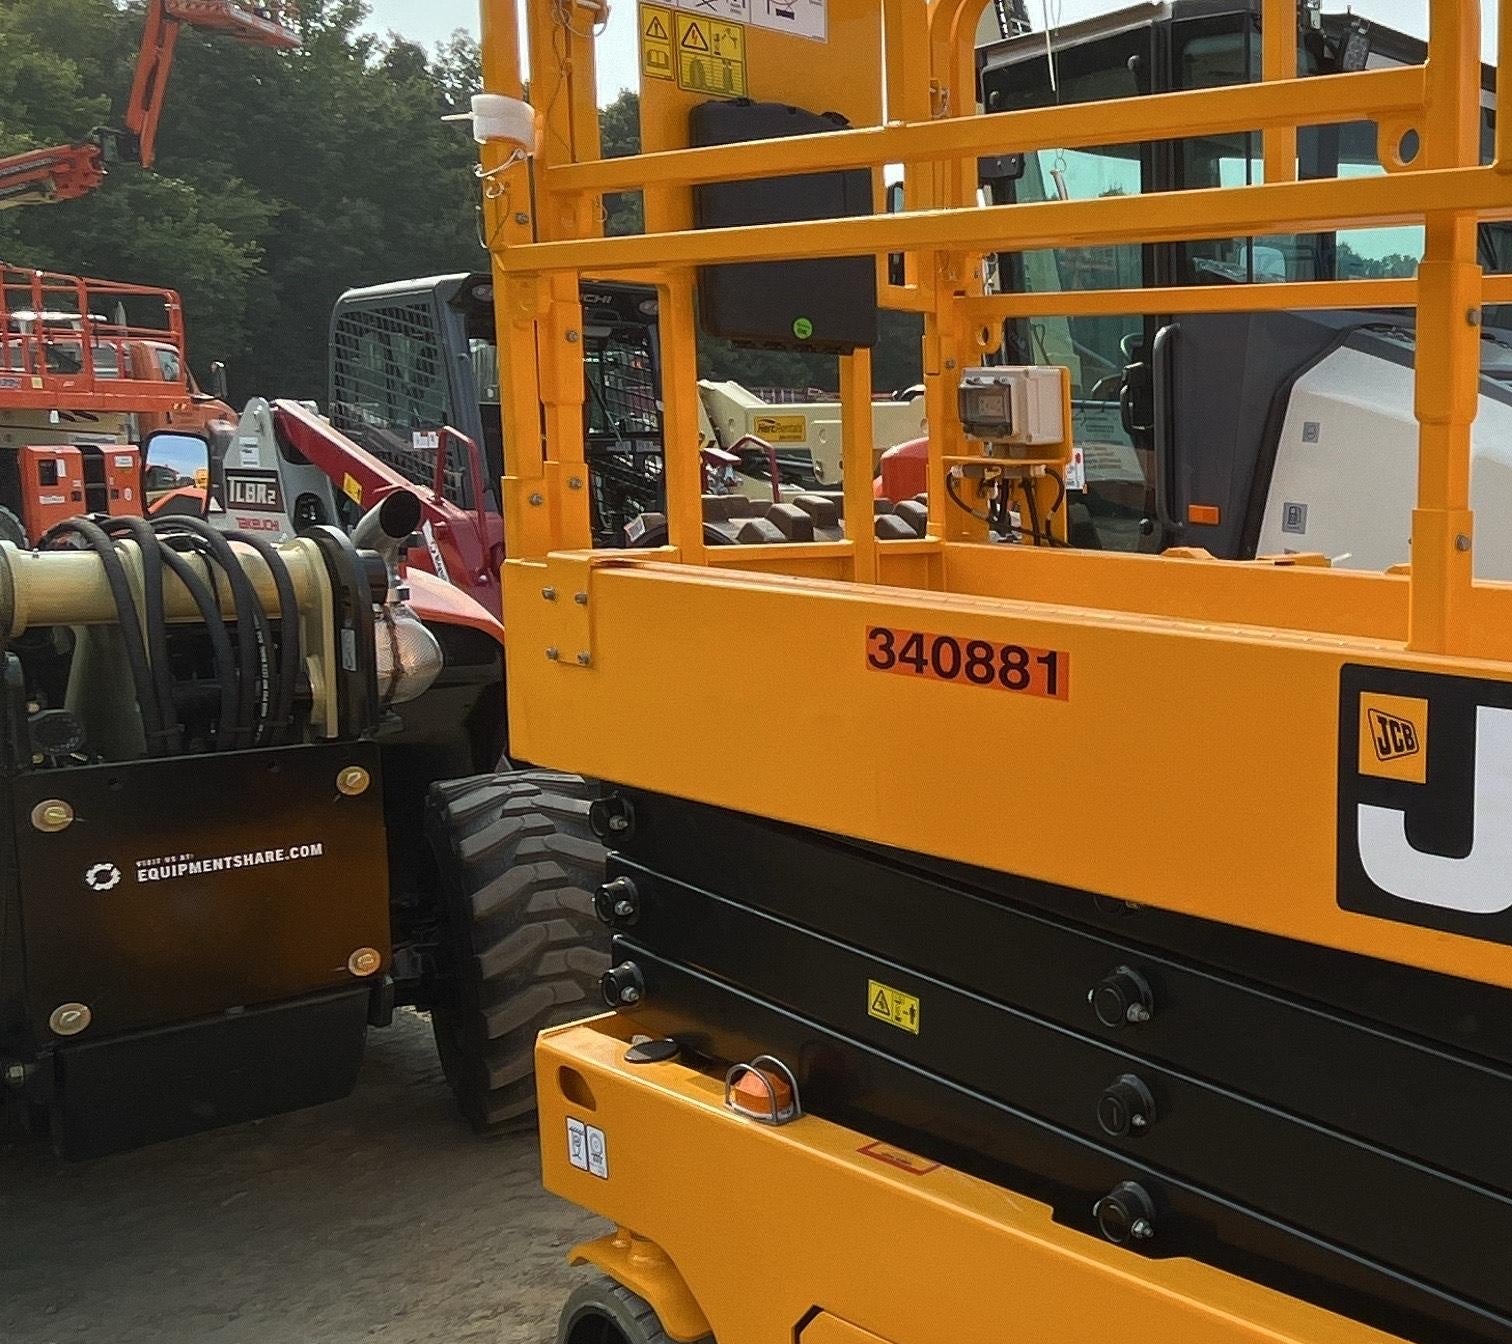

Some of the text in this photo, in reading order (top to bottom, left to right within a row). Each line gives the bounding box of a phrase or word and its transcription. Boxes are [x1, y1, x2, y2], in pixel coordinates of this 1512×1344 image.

[868, 626, 1058, 695] 340881
[1375, 714, 1416, 756] JCB
[136, 843, 323, 883] EQUIPMENTSHARE.COM
